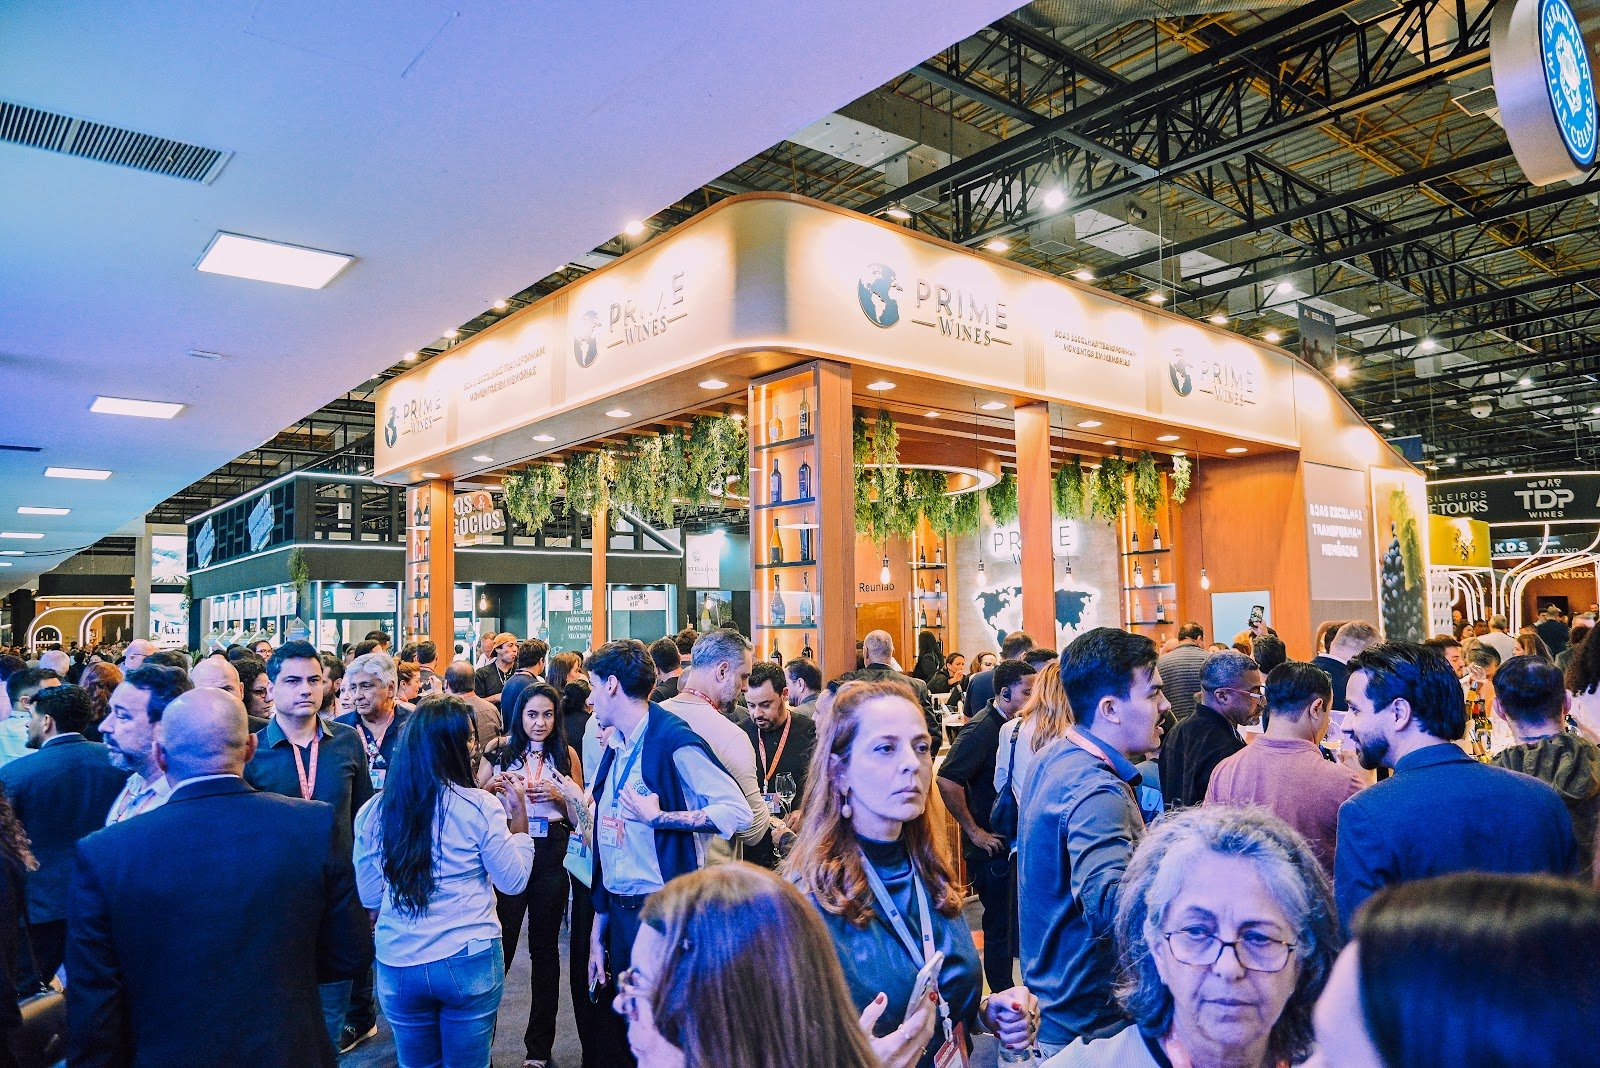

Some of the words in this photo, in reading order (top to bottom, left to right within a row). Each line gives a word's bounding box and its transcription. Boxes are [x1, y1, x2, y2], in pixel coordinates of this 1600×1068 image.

[609, 271, 685, 333] PRE
[915, 277, 1008, 330] PRIME
[624, 315, 667, 345] WINES
[937, 314, 991, 346] WINES
[1438, 500, 1489, 515] TOURS
[1513, 488, 1575, 510] TDP
[1528, 510, 1564, 519] WINES
[993, 525, 1071, 553] PRE
[1494, 541, 1529, 553] KDS
